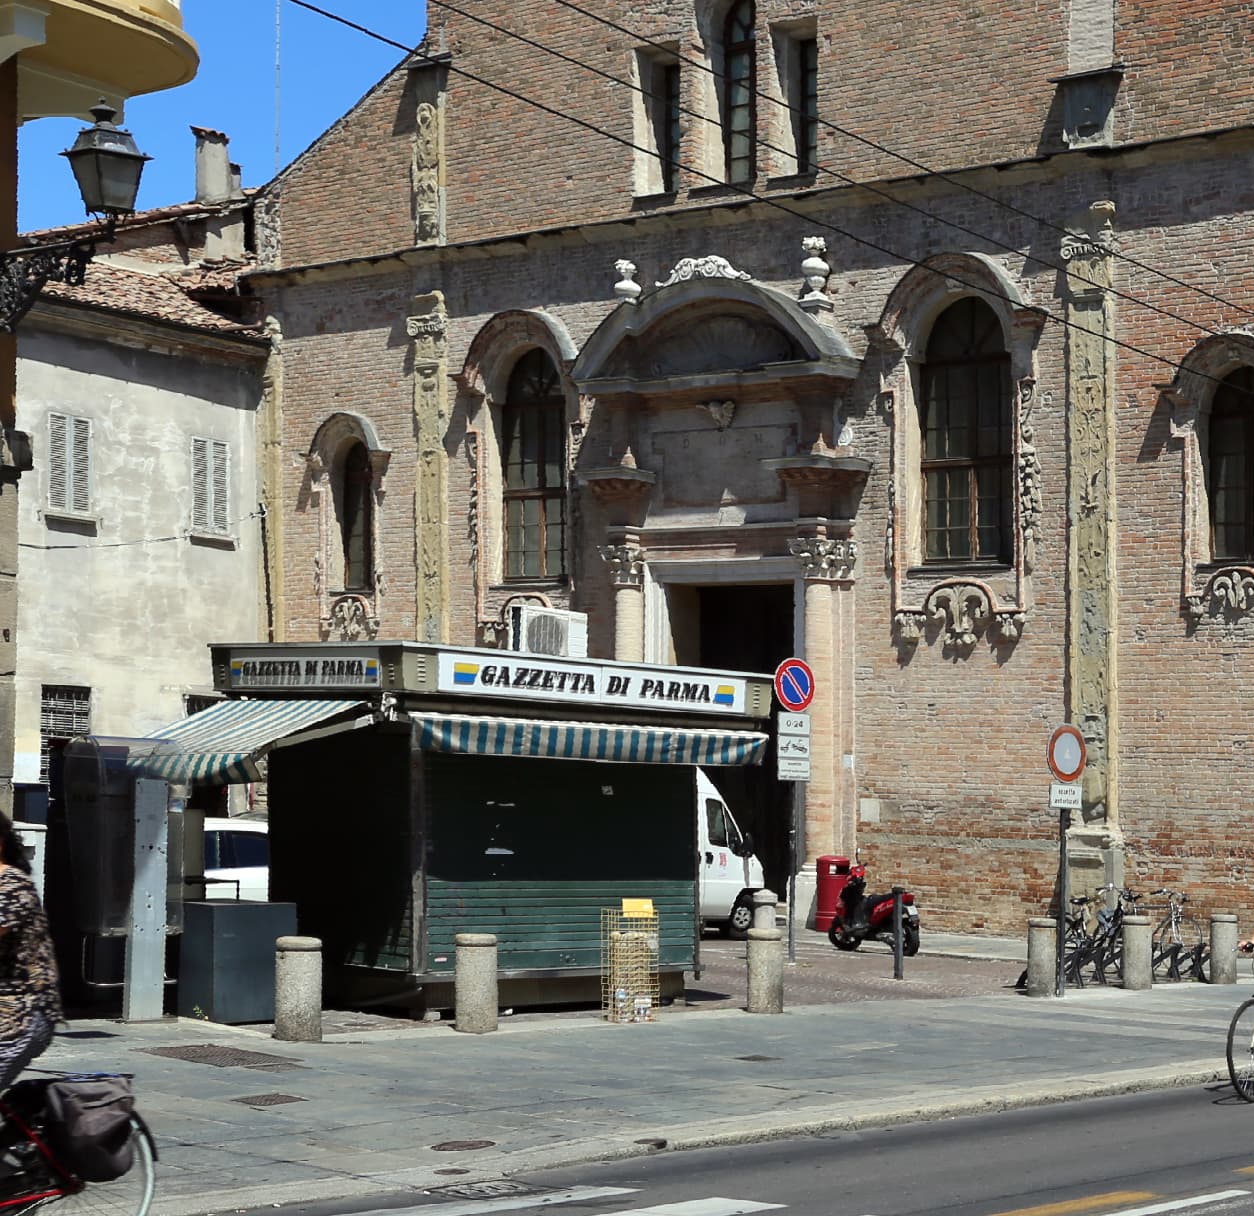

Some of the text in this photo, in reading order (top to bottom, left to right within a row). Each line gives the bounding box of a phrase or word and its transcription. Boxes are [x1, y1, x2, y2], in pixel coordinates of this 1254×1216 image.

[243, 660, 364, 676] GAZZETTA DI PARMA
[481, 665, 710, 703] GAZZETTA DI PARMA
